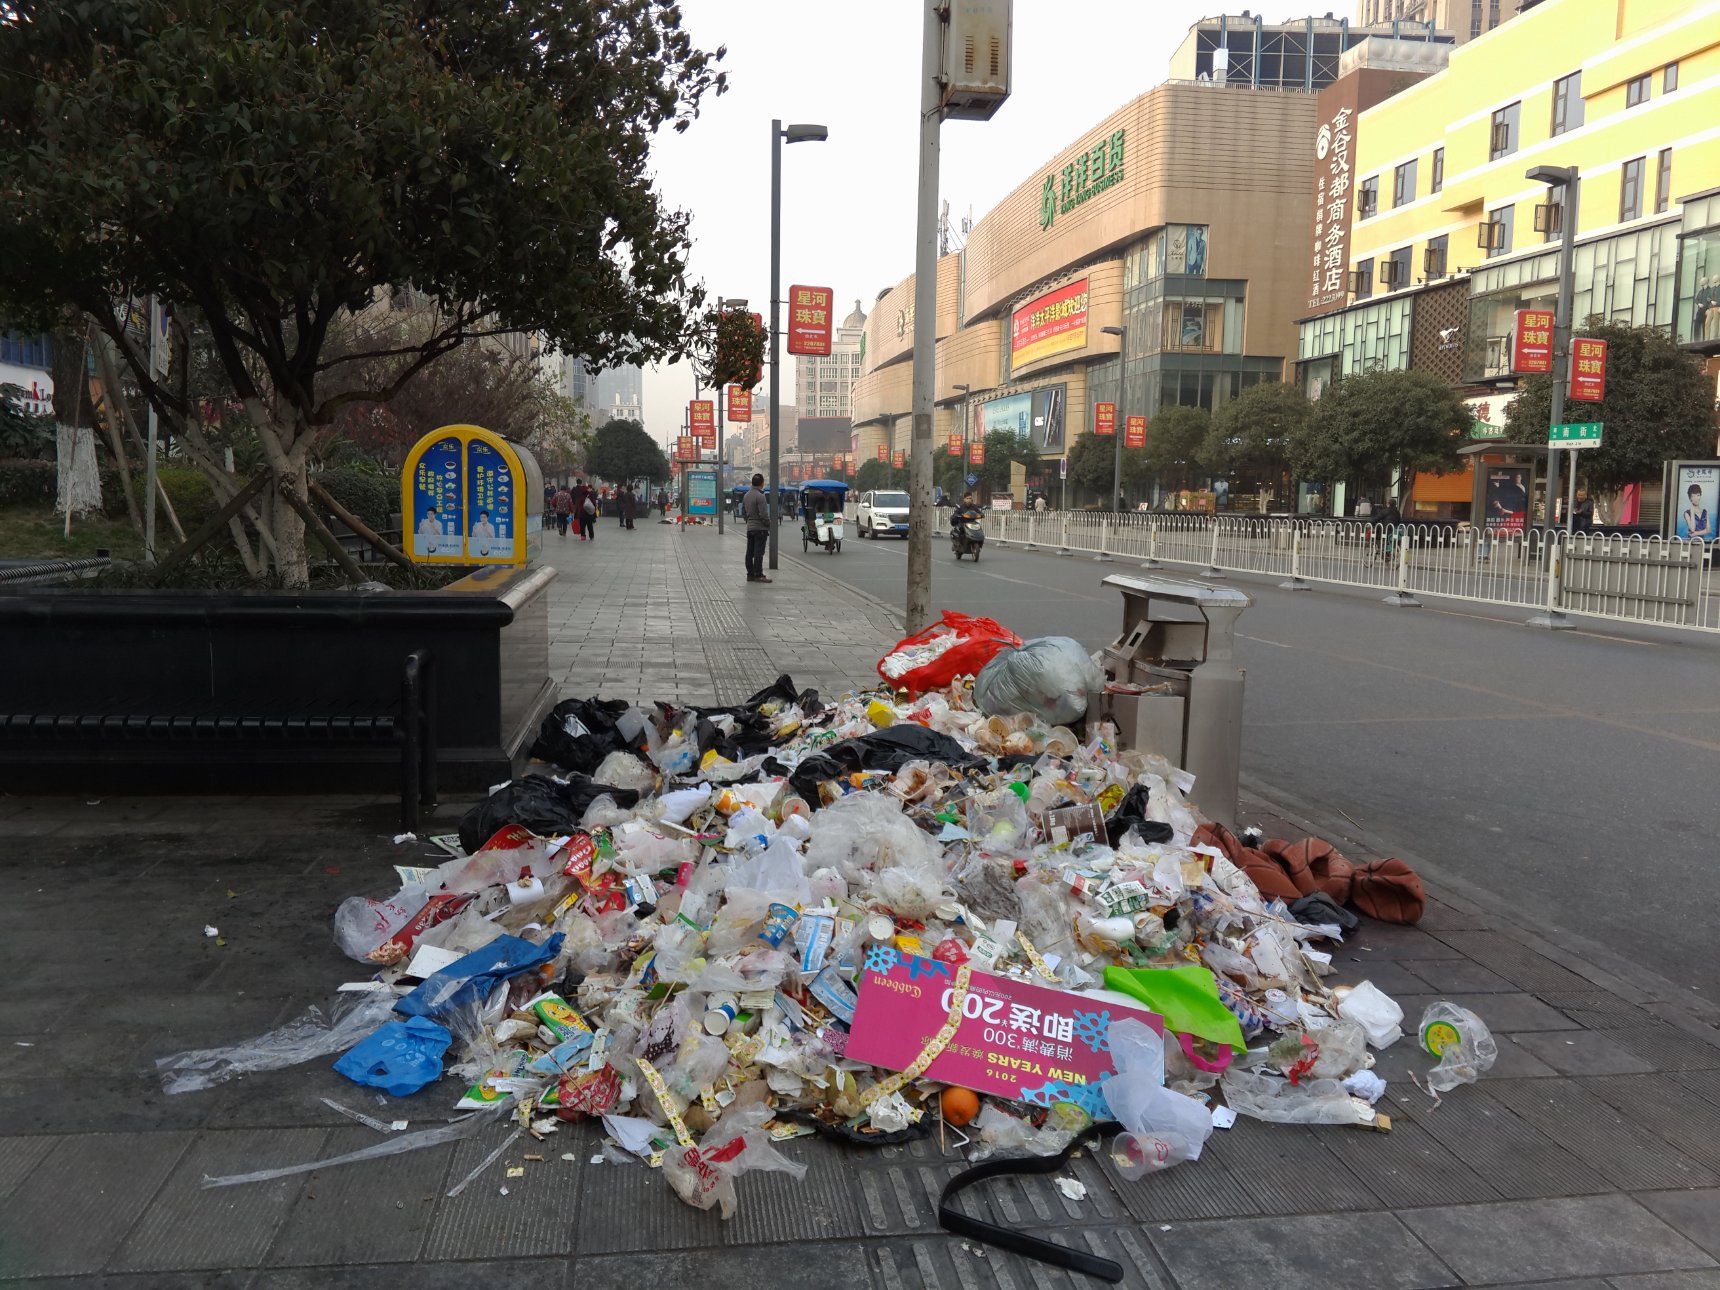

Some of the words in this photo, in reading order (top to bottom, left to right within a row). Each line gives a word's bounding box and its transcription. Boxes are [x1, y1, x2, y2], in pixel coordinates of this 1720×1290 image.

[1060, 128, 1125, 202] 洋洋百货
[1322, 107, 1352, 292] 金谷汉都商务酒店
[797, 290, 827, 306] 星河
[796, 309, 826, 325] 珠寶
[1524, 314, 1550, 328] 星河
[1523, 331, 1549, 345] 珠寶
[1579, 343, 1603, 358] 星河
[1578, 360, 1602, 374] 珠寶
[873, 976, 921, 999] Cabbeen
[920, 1036, 984, 1061] 焕发新你
[987, 1052, 1043, 1077] YEARS
[986, 1069, 1017, 1083] 2016
[1047, 1067, 1086, 1086] NEW
